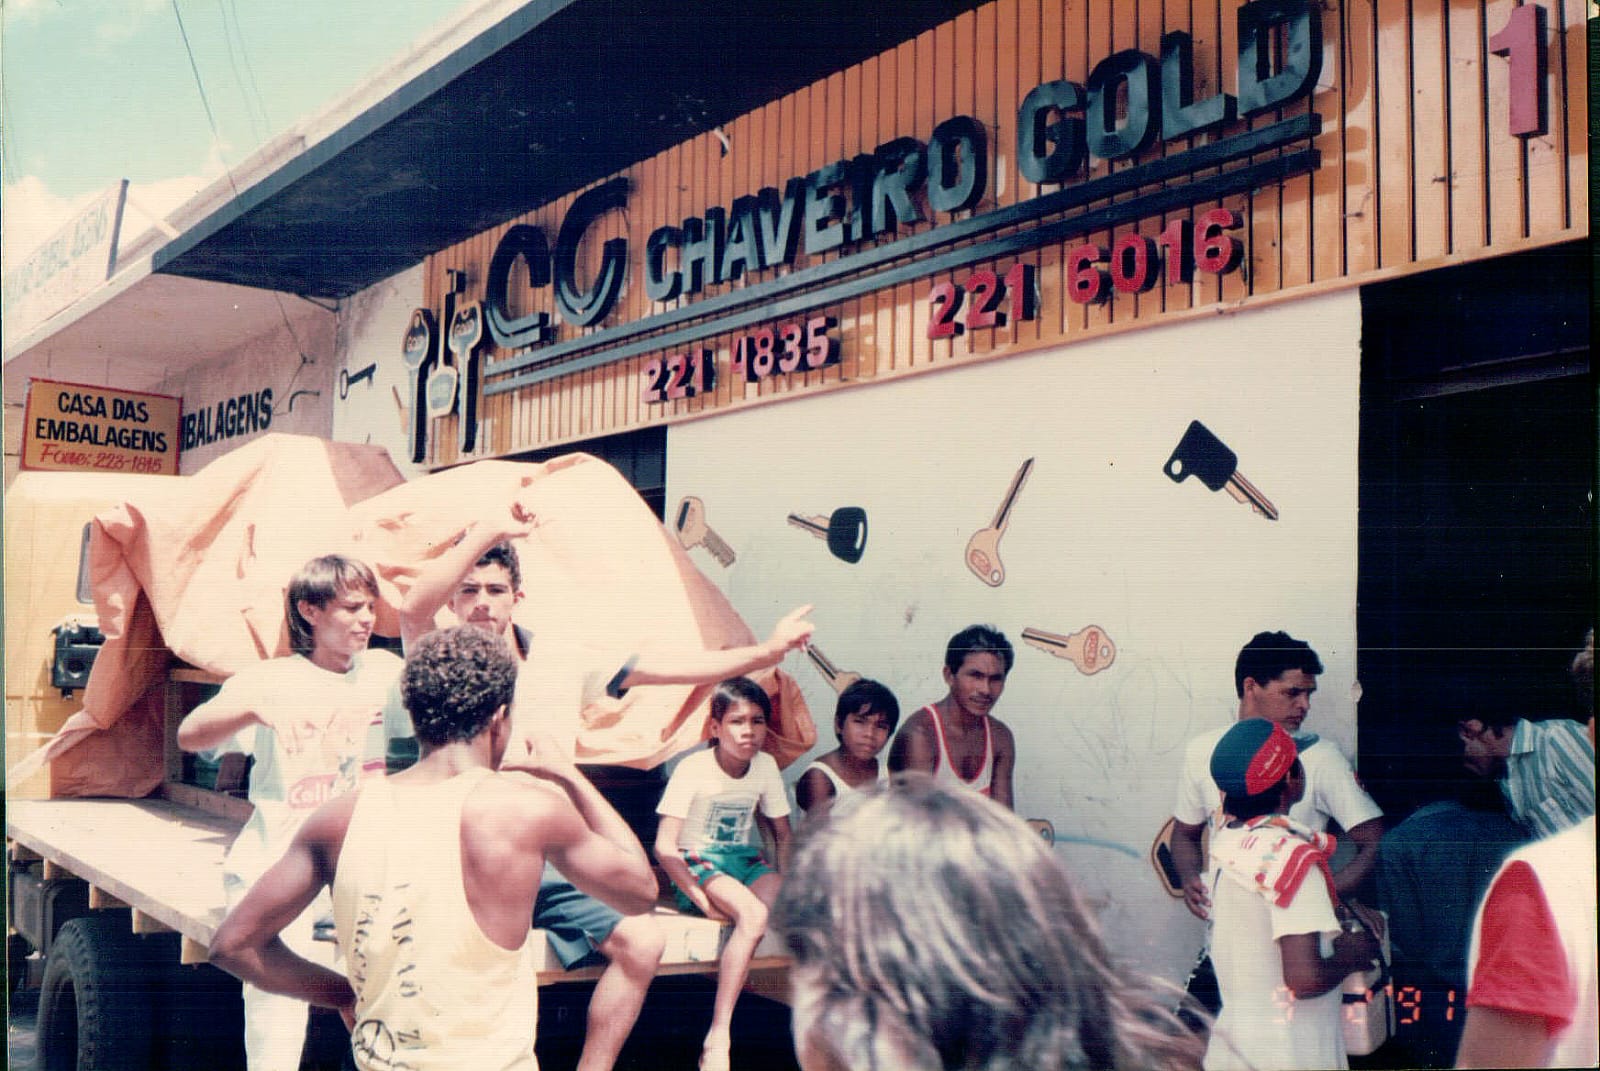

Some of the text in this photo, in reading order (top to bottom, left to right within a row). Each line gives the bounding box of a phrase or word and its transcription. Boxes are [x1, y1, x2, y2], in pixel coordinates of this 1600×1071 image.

[1488, 4, 1548, 137] 1
[645, 115, 988, 302] CHAVEIRO
[1018, 0, 1323, 185] GOLD
[927, 208, 1244, 340] 221 6016
[58, 391, 150, 424] CASA DAS
[643, 316, 840, 403] 221 4835
[35, 417, 168, 453] EMBALAGENS
